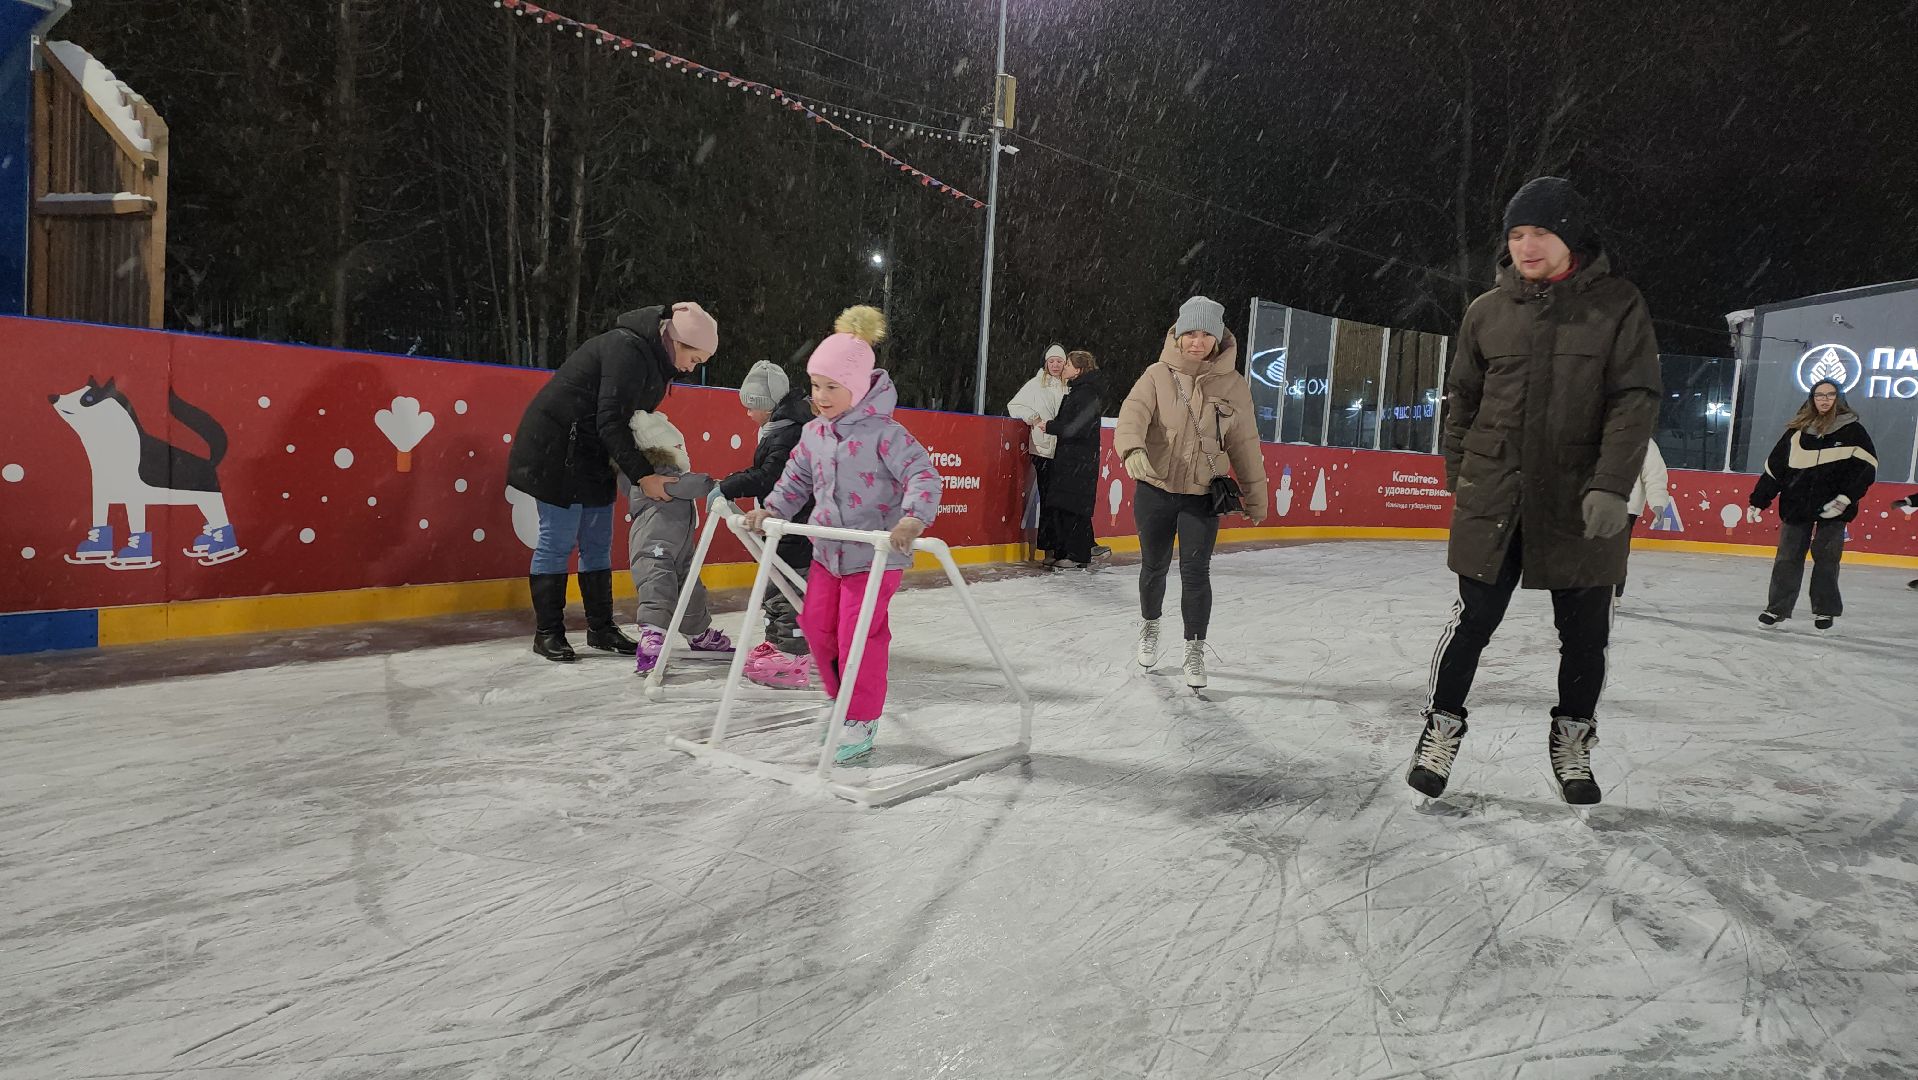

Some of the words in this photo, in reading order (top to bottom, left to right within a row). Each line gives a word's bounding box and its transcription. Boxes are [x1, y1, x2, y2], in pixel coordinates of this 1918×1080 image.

[927, 446, 961, 467] йтесь
[1392, 471, 1438, 484] Катайтесь
[1377, 486, 1383, 494] с
[936, 504, 967, 515] рнатора
[1409, 502, 1442, 512] губернатора
